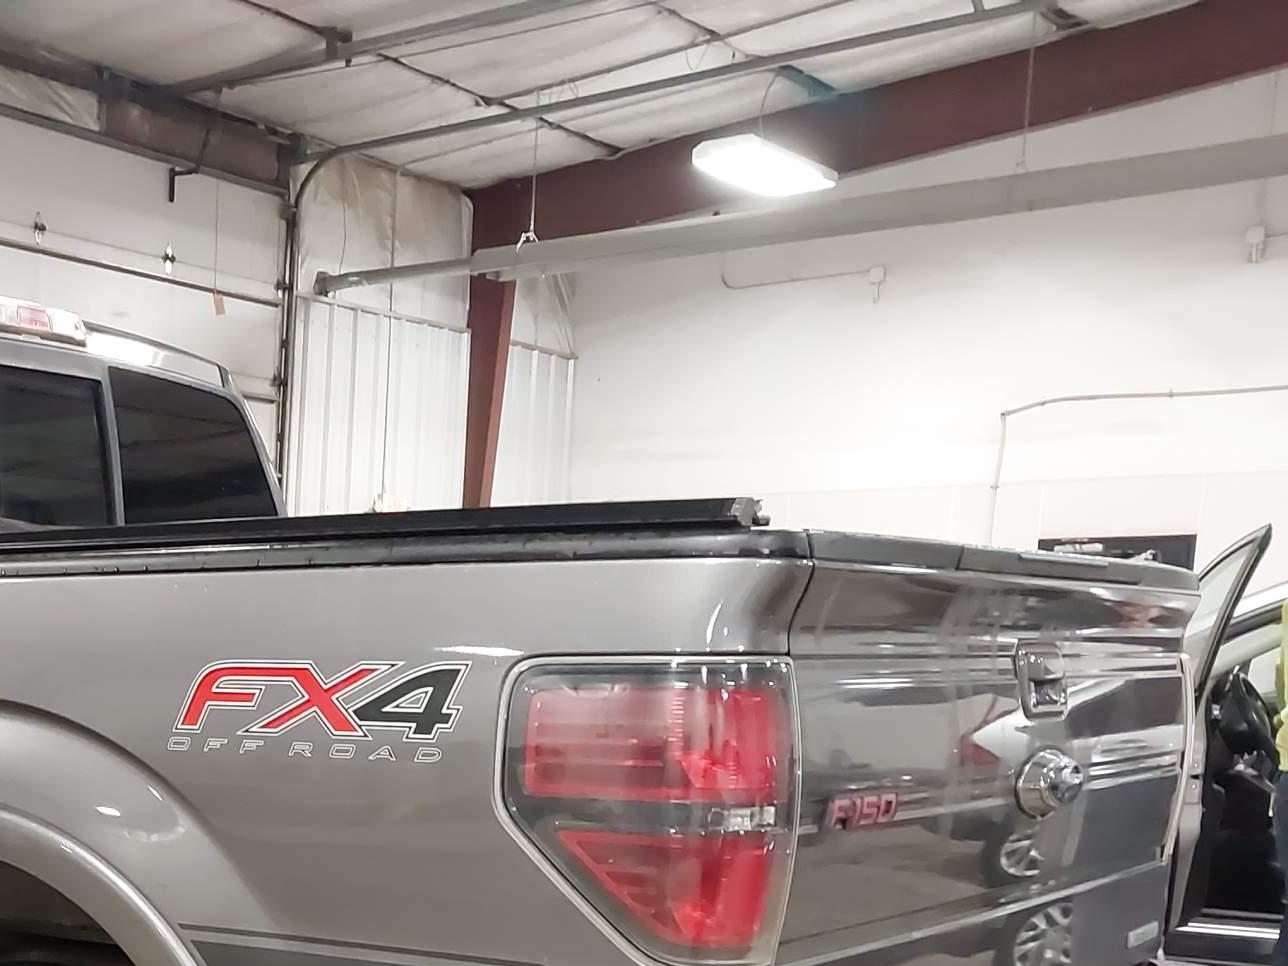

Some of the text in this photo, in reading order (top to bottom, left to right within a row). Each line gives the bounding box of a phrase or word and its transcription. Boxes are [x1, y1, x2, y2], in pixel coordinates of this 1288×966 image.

[172, 659, 472, 742] FX4
[167, 736, 442, 763] OFF ROAD
